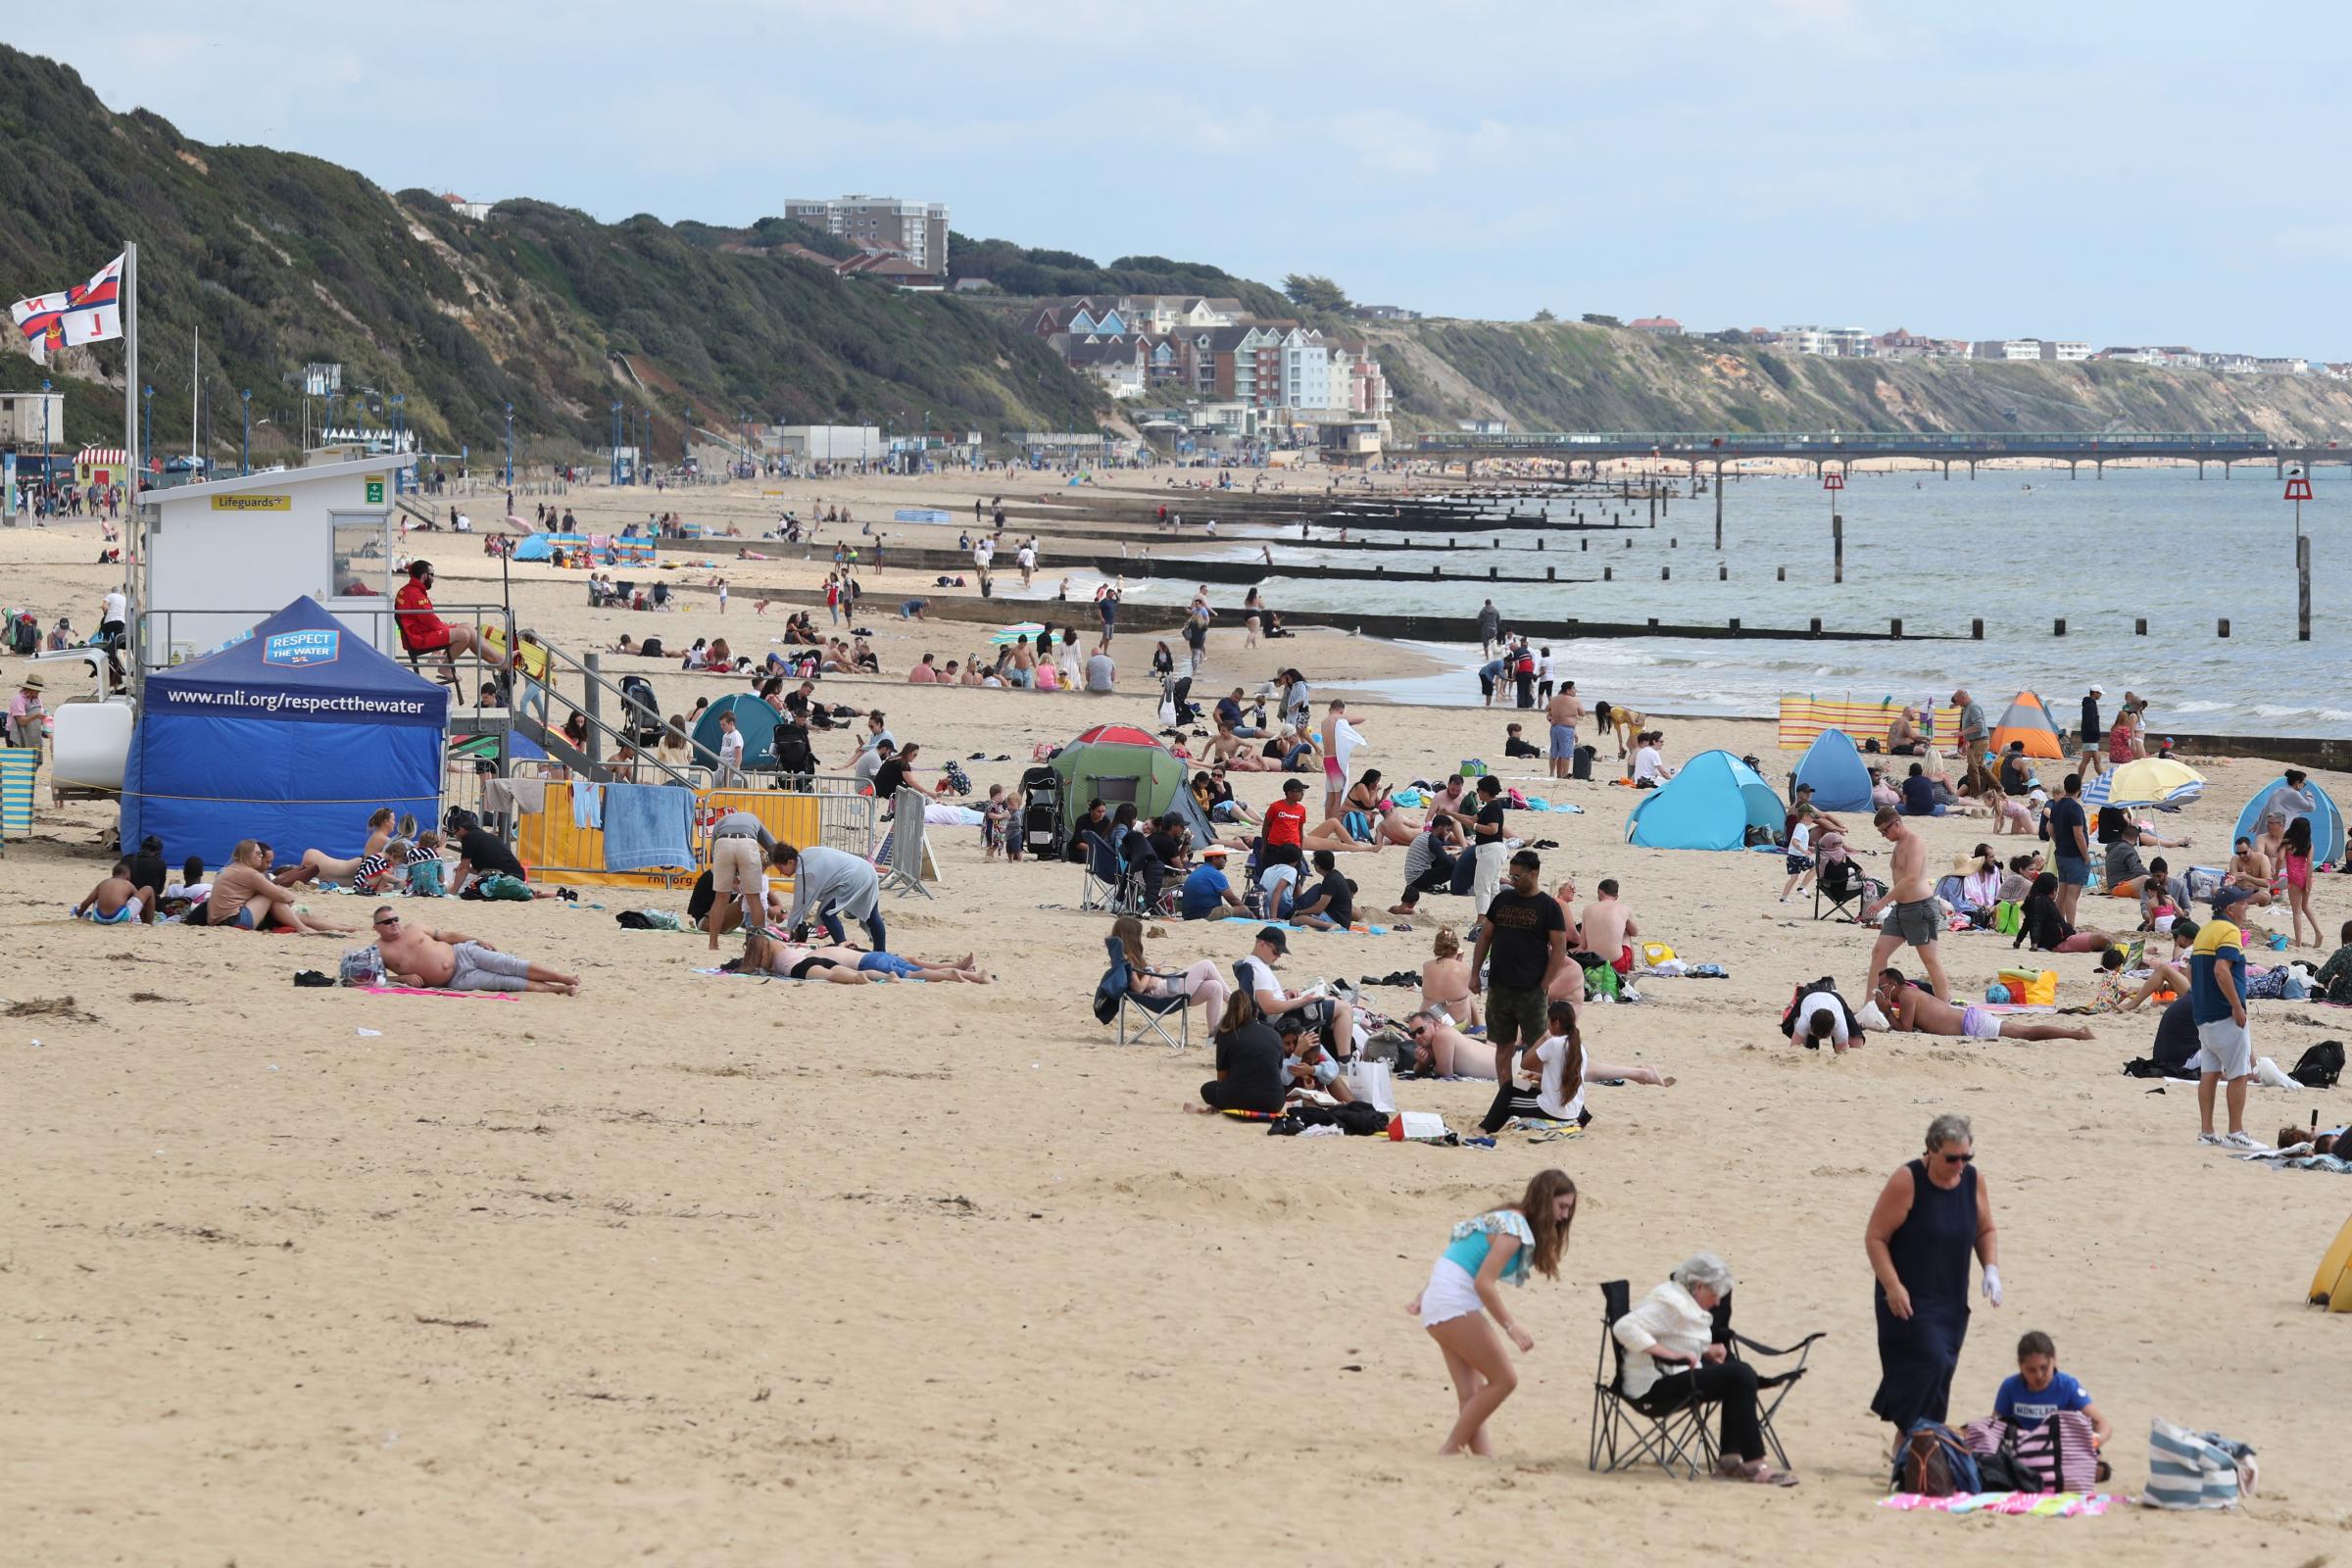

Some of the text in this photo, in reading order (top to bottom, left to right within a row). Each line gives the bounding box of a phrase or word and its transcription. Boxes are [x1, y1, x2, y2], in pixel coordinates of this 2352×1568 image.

[219, 497, 274, 510] Lifeguards
[273, 634, 330, 648] RESPECT
[273, 647, 329, 658] THE WATER
[168, 690, 424, 713] www.rnli.org/respectthewater
[648, 875, 696, 887] rnlorg.
